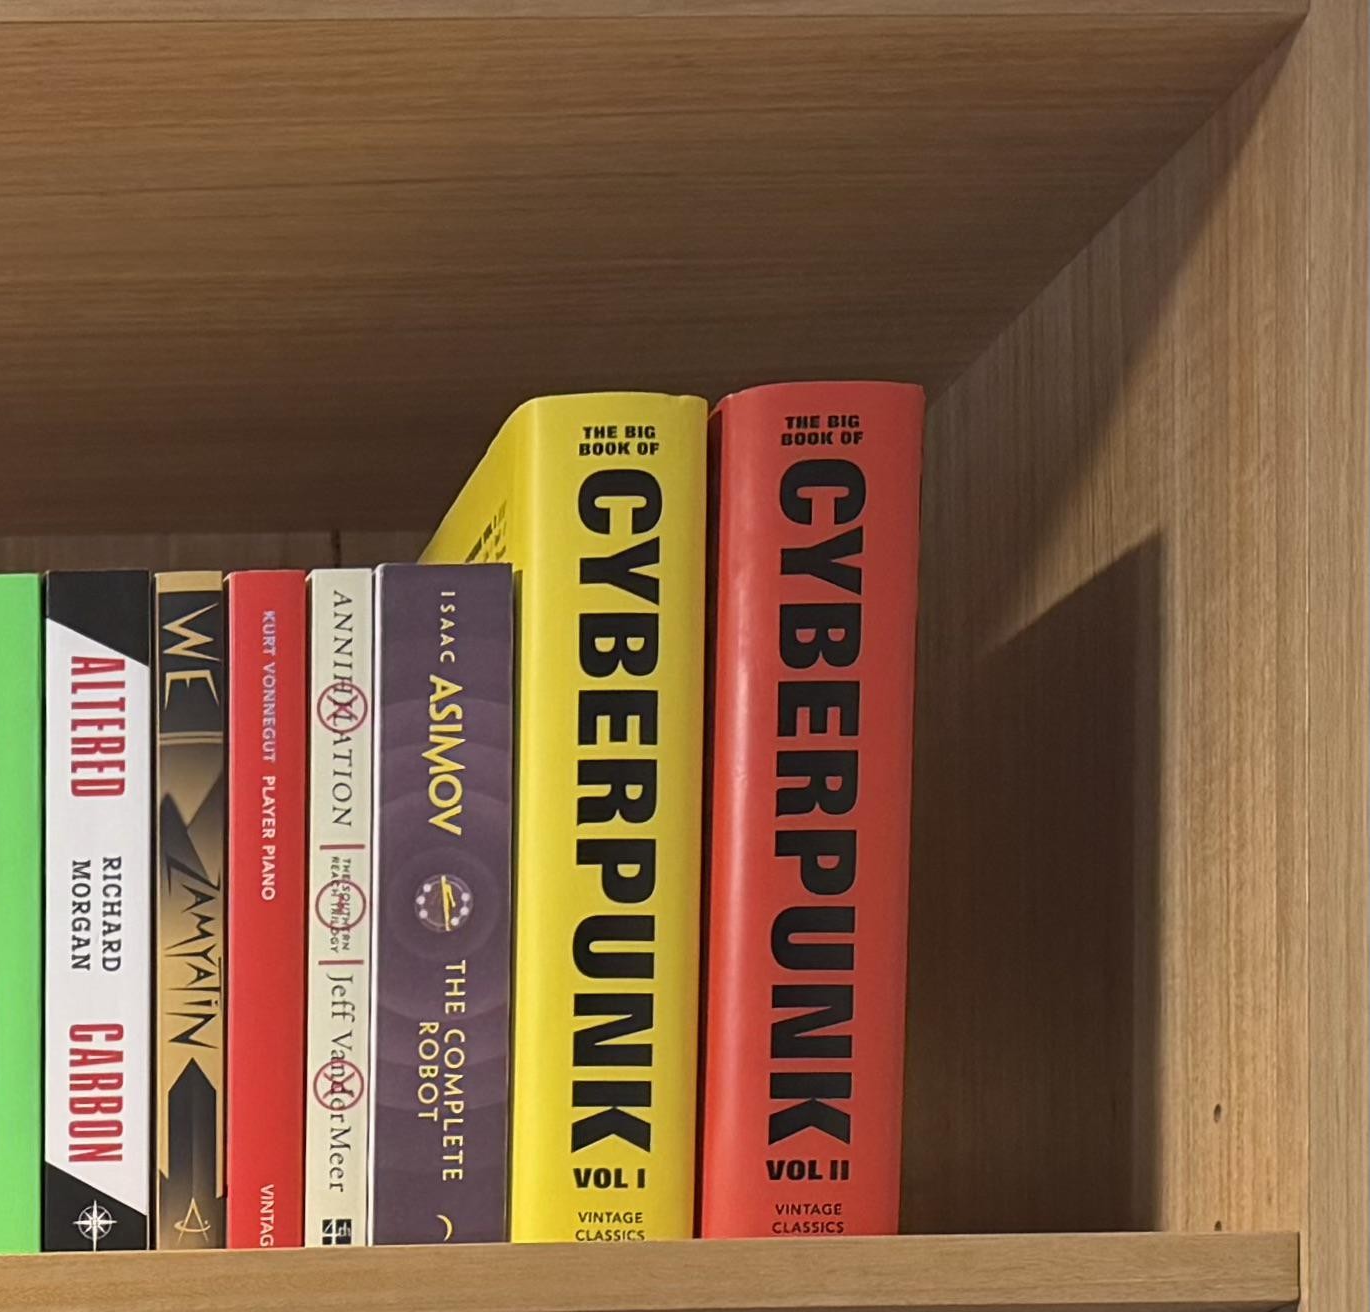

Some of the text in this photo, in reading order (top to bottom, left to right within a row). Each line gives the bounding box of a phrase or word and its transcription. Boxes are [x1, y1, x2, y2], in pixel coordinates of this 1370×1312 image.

[70, 655, 125, 796] ALTERED
[429, 673, 462, 836] ASIMOV
[571, 468, 662, 1153] CYBERPUNK
[73, 860, 91, 971] MORGAN
[102, 856, 122, 973] RICHARD
[69, 1023, 124, 1162] CARBON
[417, 1022, 438, 1122] ROBOT
[443, 960, 464, 1181] THE COMPLETE
[573, 1168, 646, 1189] VOL I
[772, 1221, 845, 1234] CLASSICS
[775, 1203, 842, 1216] VINTAGE
